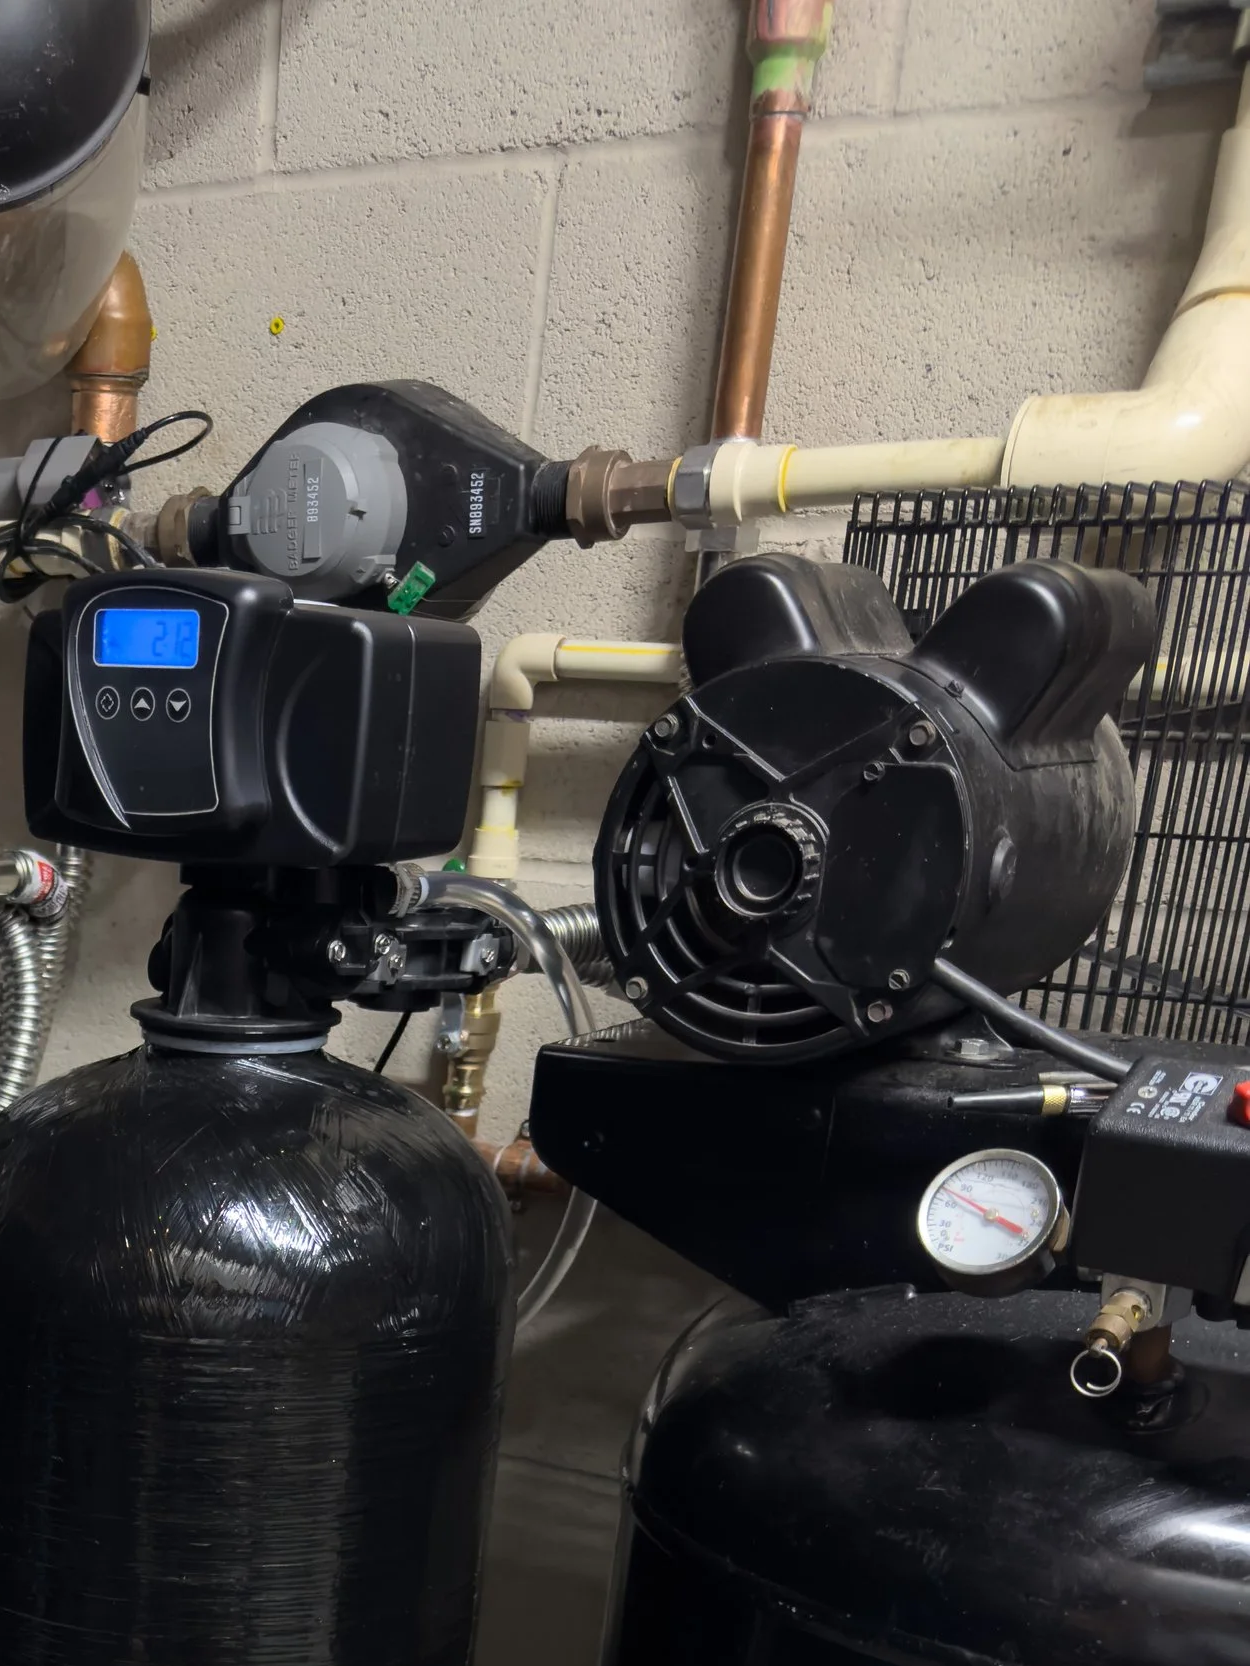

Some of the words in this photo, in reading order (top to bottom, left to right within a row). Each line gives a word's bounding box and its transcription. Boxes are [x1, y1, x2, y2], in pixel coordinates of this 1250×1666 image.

[306, 476, 320, 523] 893452
[468, 472, 485, 534] SN893452
[938, 1243, 954, 1252] PSI
